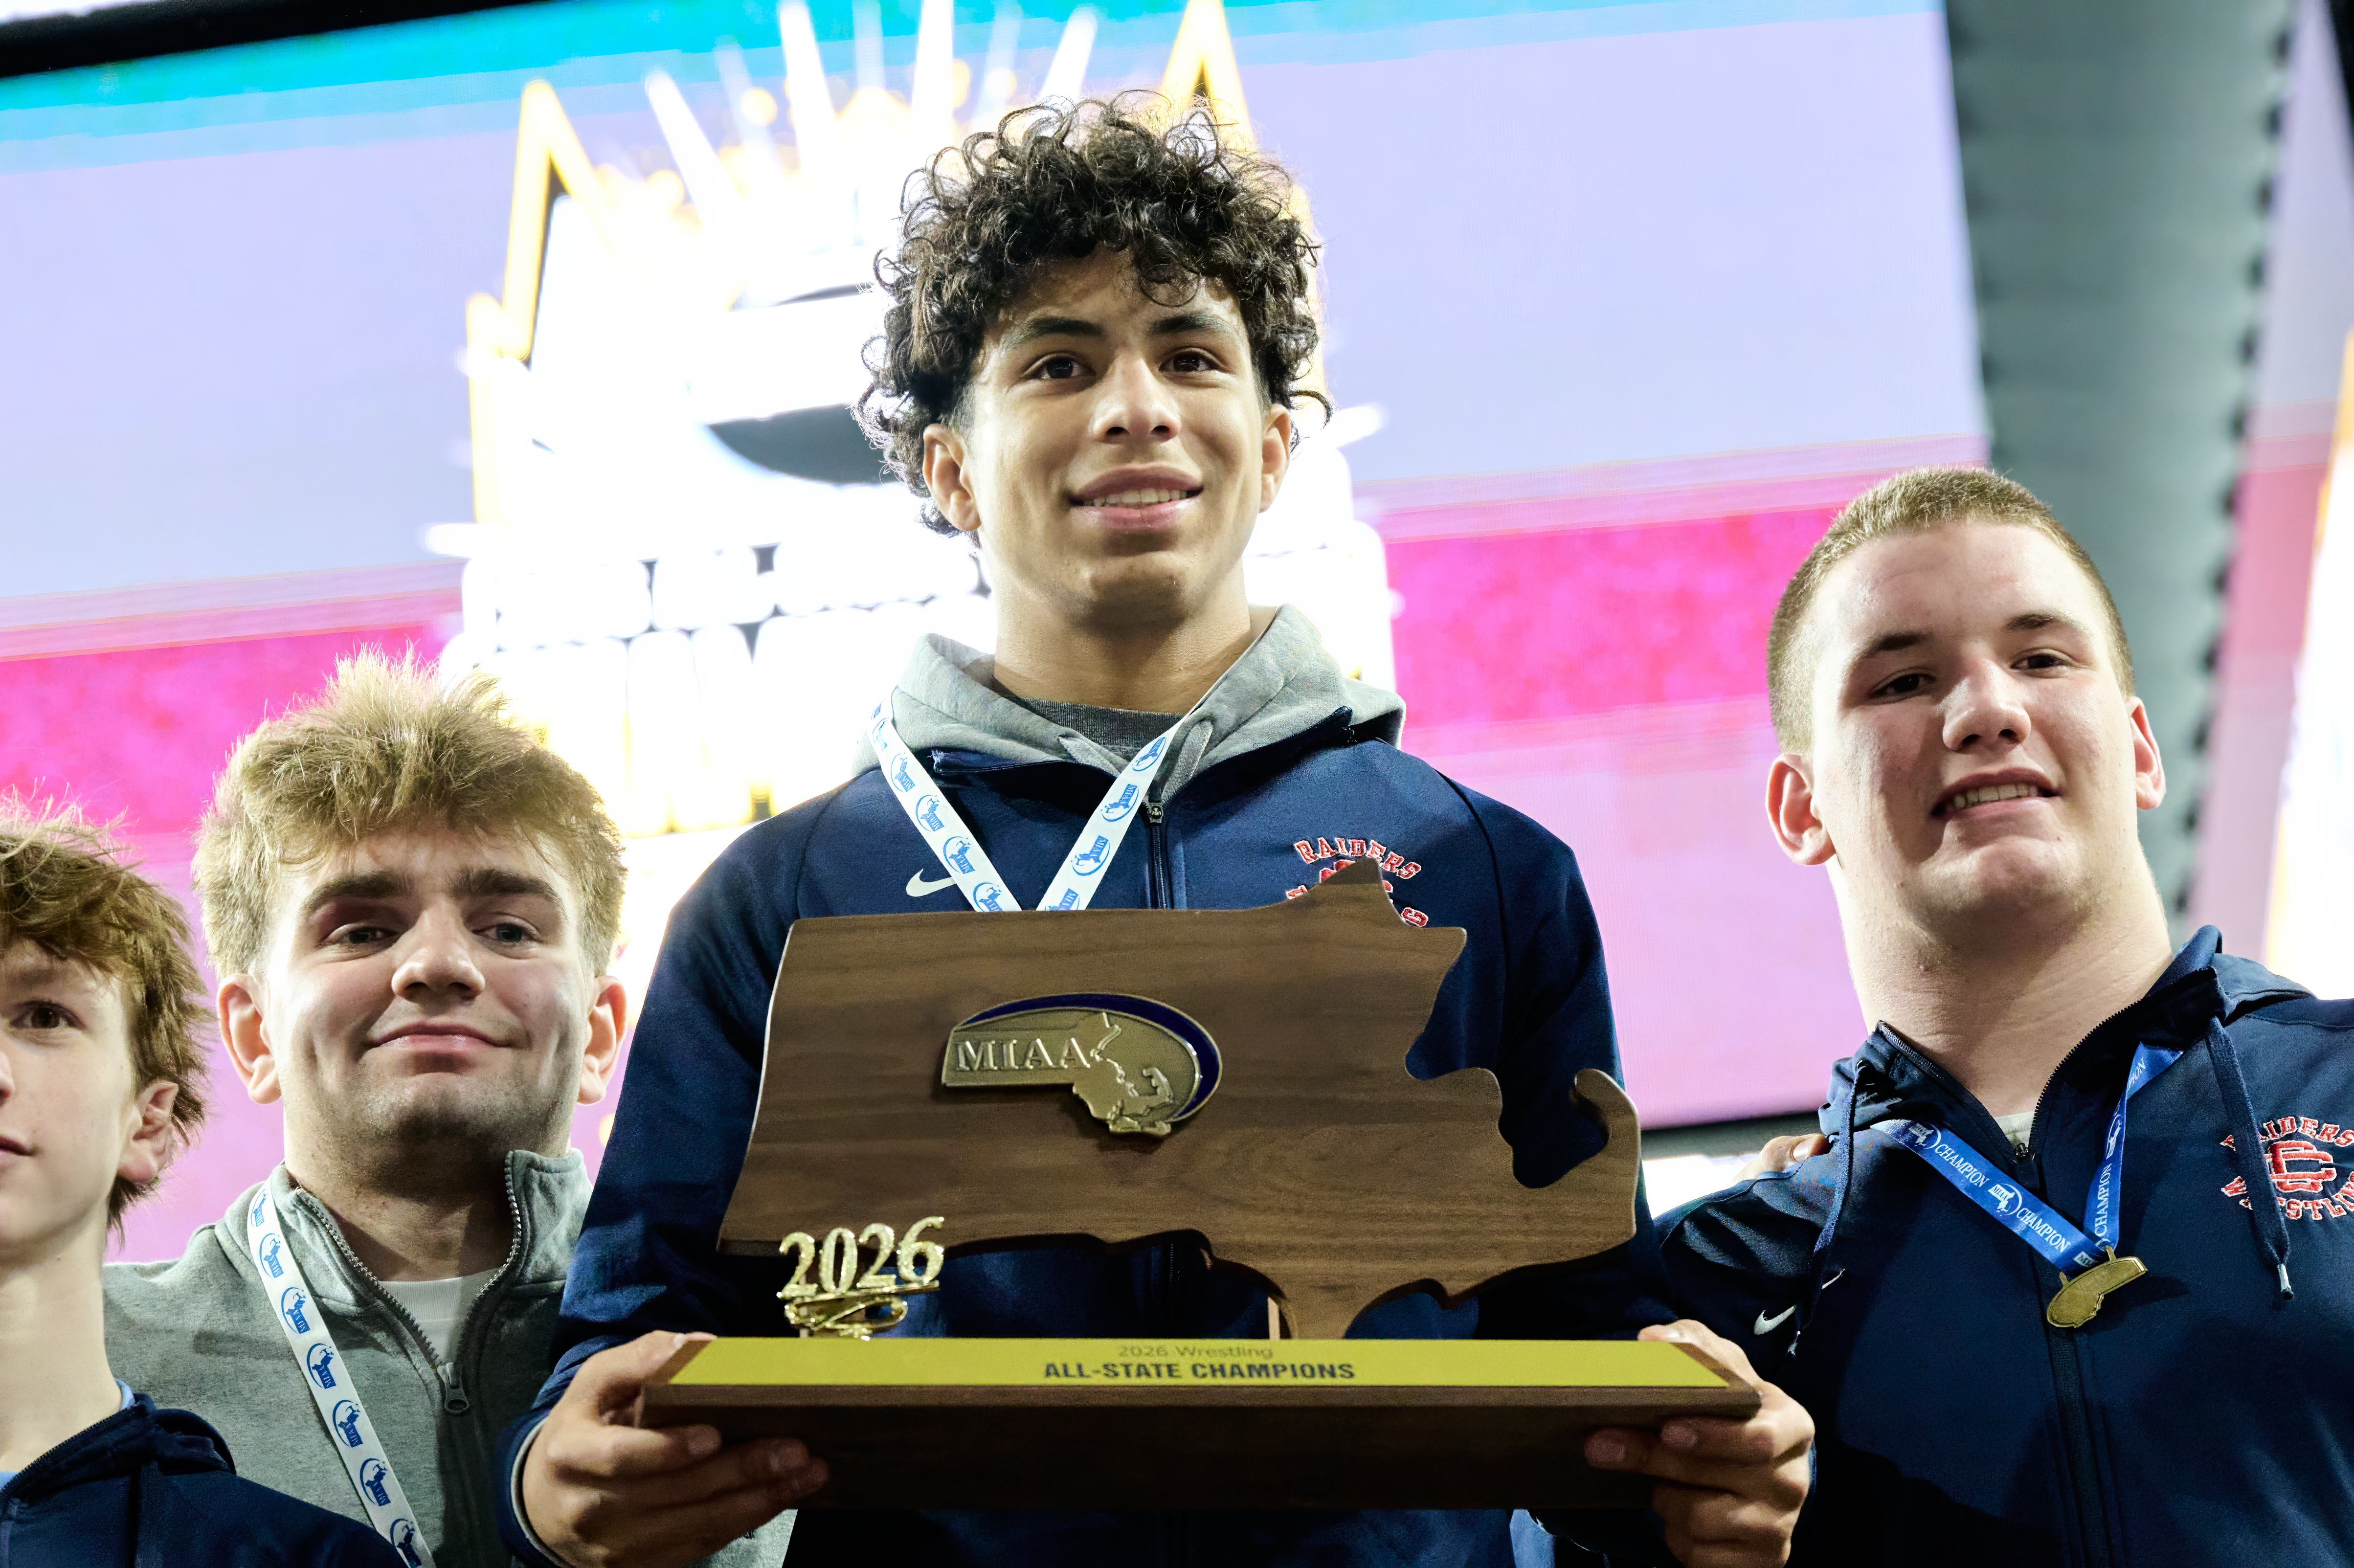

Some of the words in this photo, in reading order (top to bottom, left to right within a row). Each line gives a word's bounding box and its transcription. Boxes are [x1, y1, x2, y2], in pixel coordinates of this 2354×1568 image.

[1294, 837, 1422, 879] RAIDERS
[956, 1037, 1091, 1071] MIAA
[1935, 1144, 1990, 1187] CHAMPION
[2016, 1208, 2071, 1253] CHAMPION
[2094, 1163, 2113, 1237] CHAMPION
[776, 1216, 944, 1300] 2026
[1044, 1363, 1182, 1379] ALL-STATE
[1192, 1363, 1355, 1379] CHAMPIONS
[1118, 1345, 1168, 1358] 2026
[1174, 1345, 1274, 1360] Wrestling
